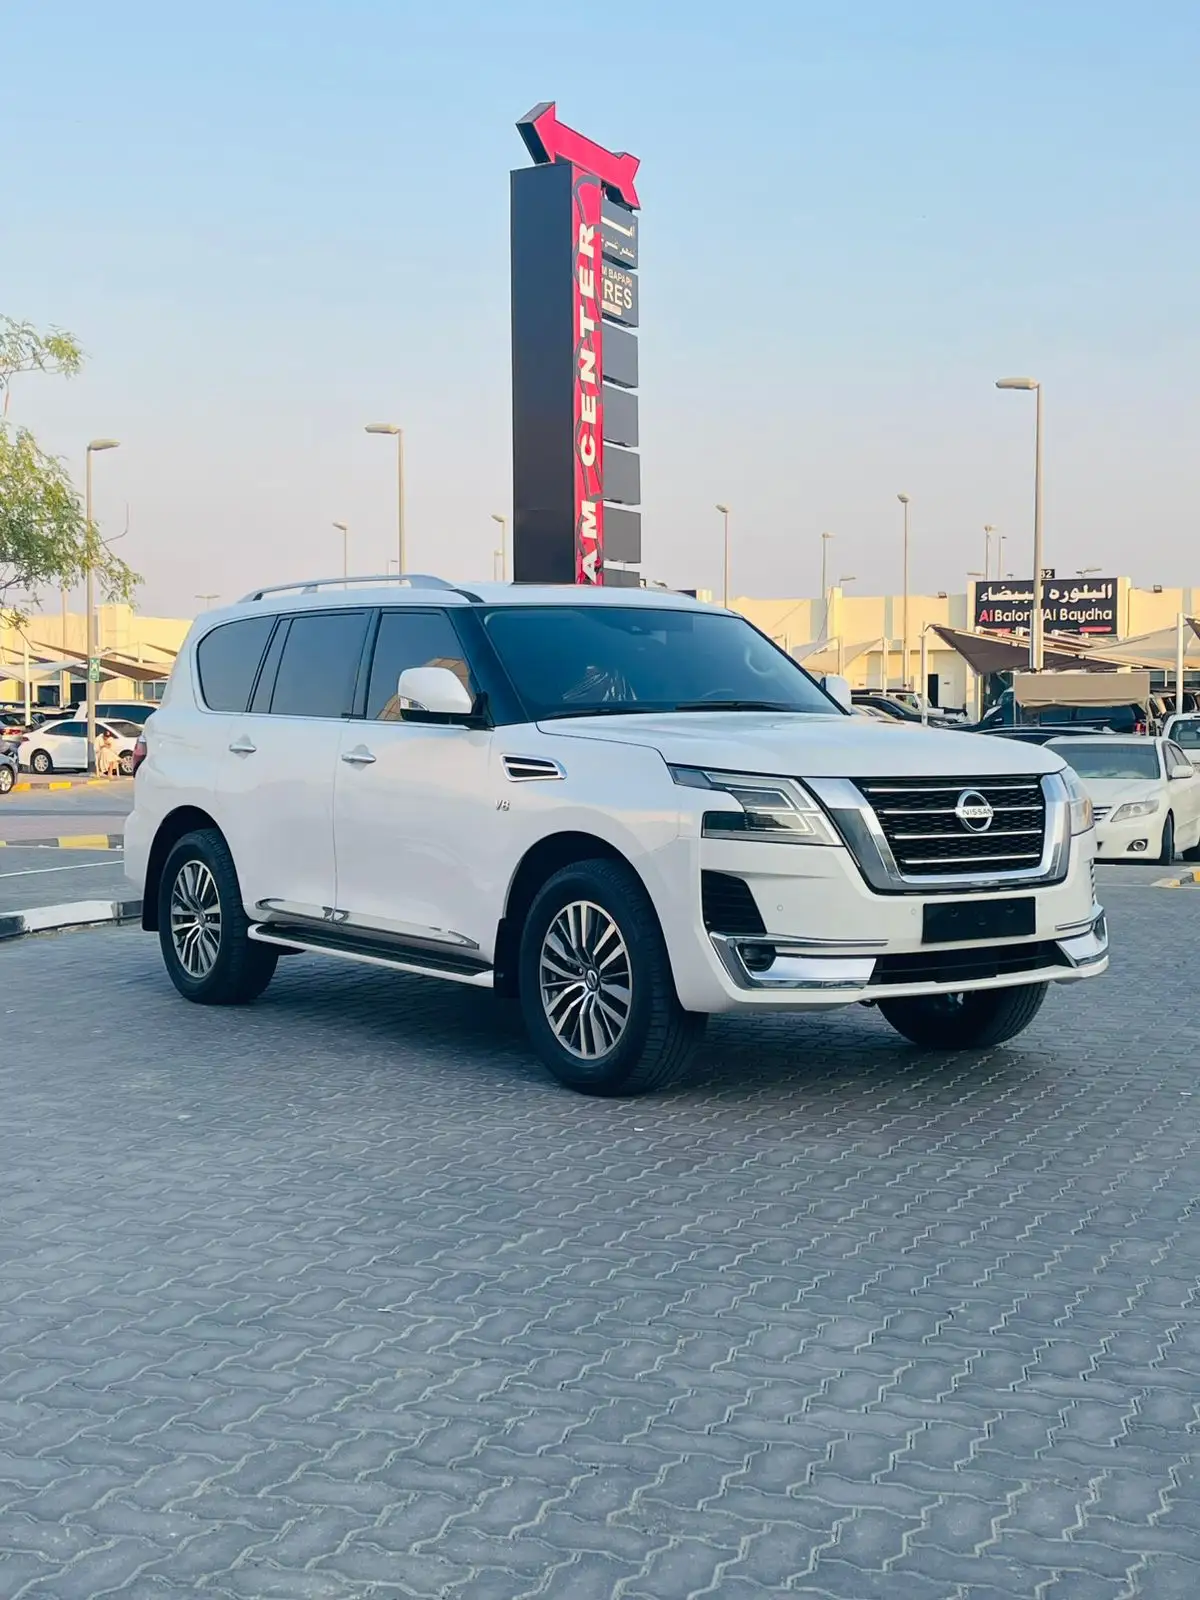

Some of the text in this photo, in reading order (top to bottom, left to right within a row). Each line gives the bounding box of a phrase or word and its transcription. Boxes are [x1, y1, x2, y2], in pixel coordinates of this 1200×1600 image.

[579, 222, 597, 467] CENTER
[1060, 608, 1113, 623] Baydha
[495, 799, 510, 812] V8
[962, 807, 993, 816] NISSAN
